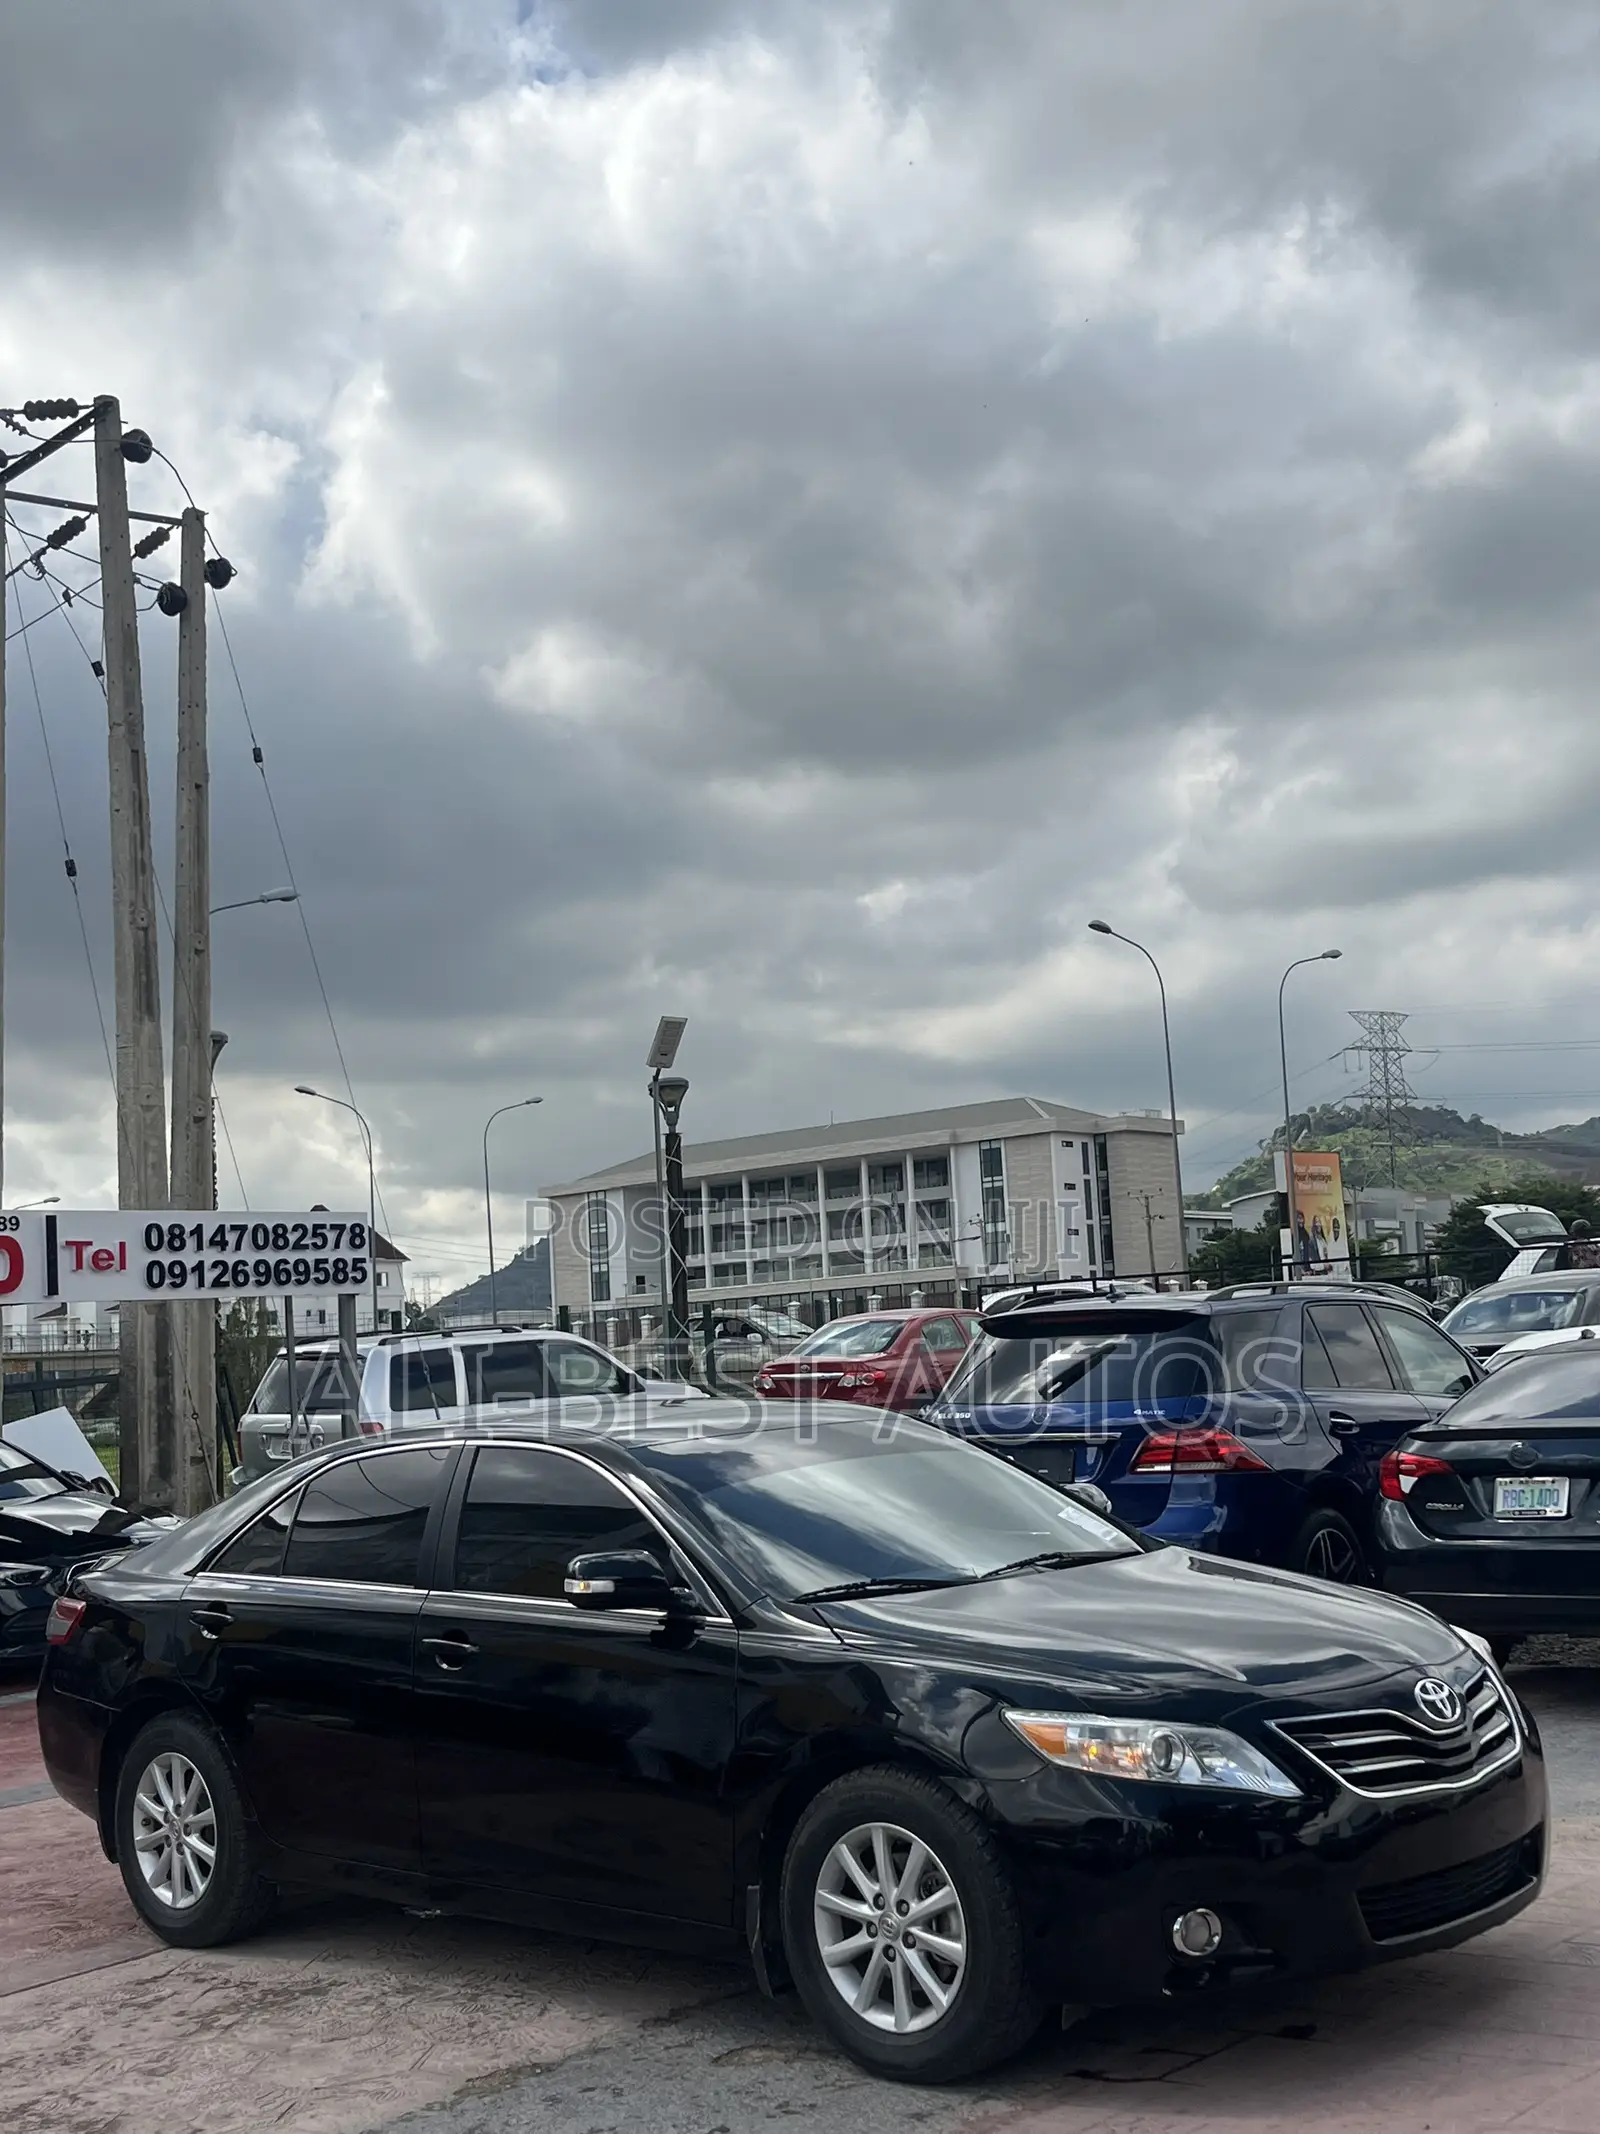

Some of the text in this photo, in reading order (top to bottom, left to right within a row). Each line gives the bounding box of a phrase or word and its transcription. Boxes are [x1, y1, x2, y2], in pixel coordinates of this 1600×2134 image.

[145, 1223, 366, 1251] 08147082578
[64, 1240, 127, 1272] Tel
[146, 1258, 368, 1288] 09126969585
